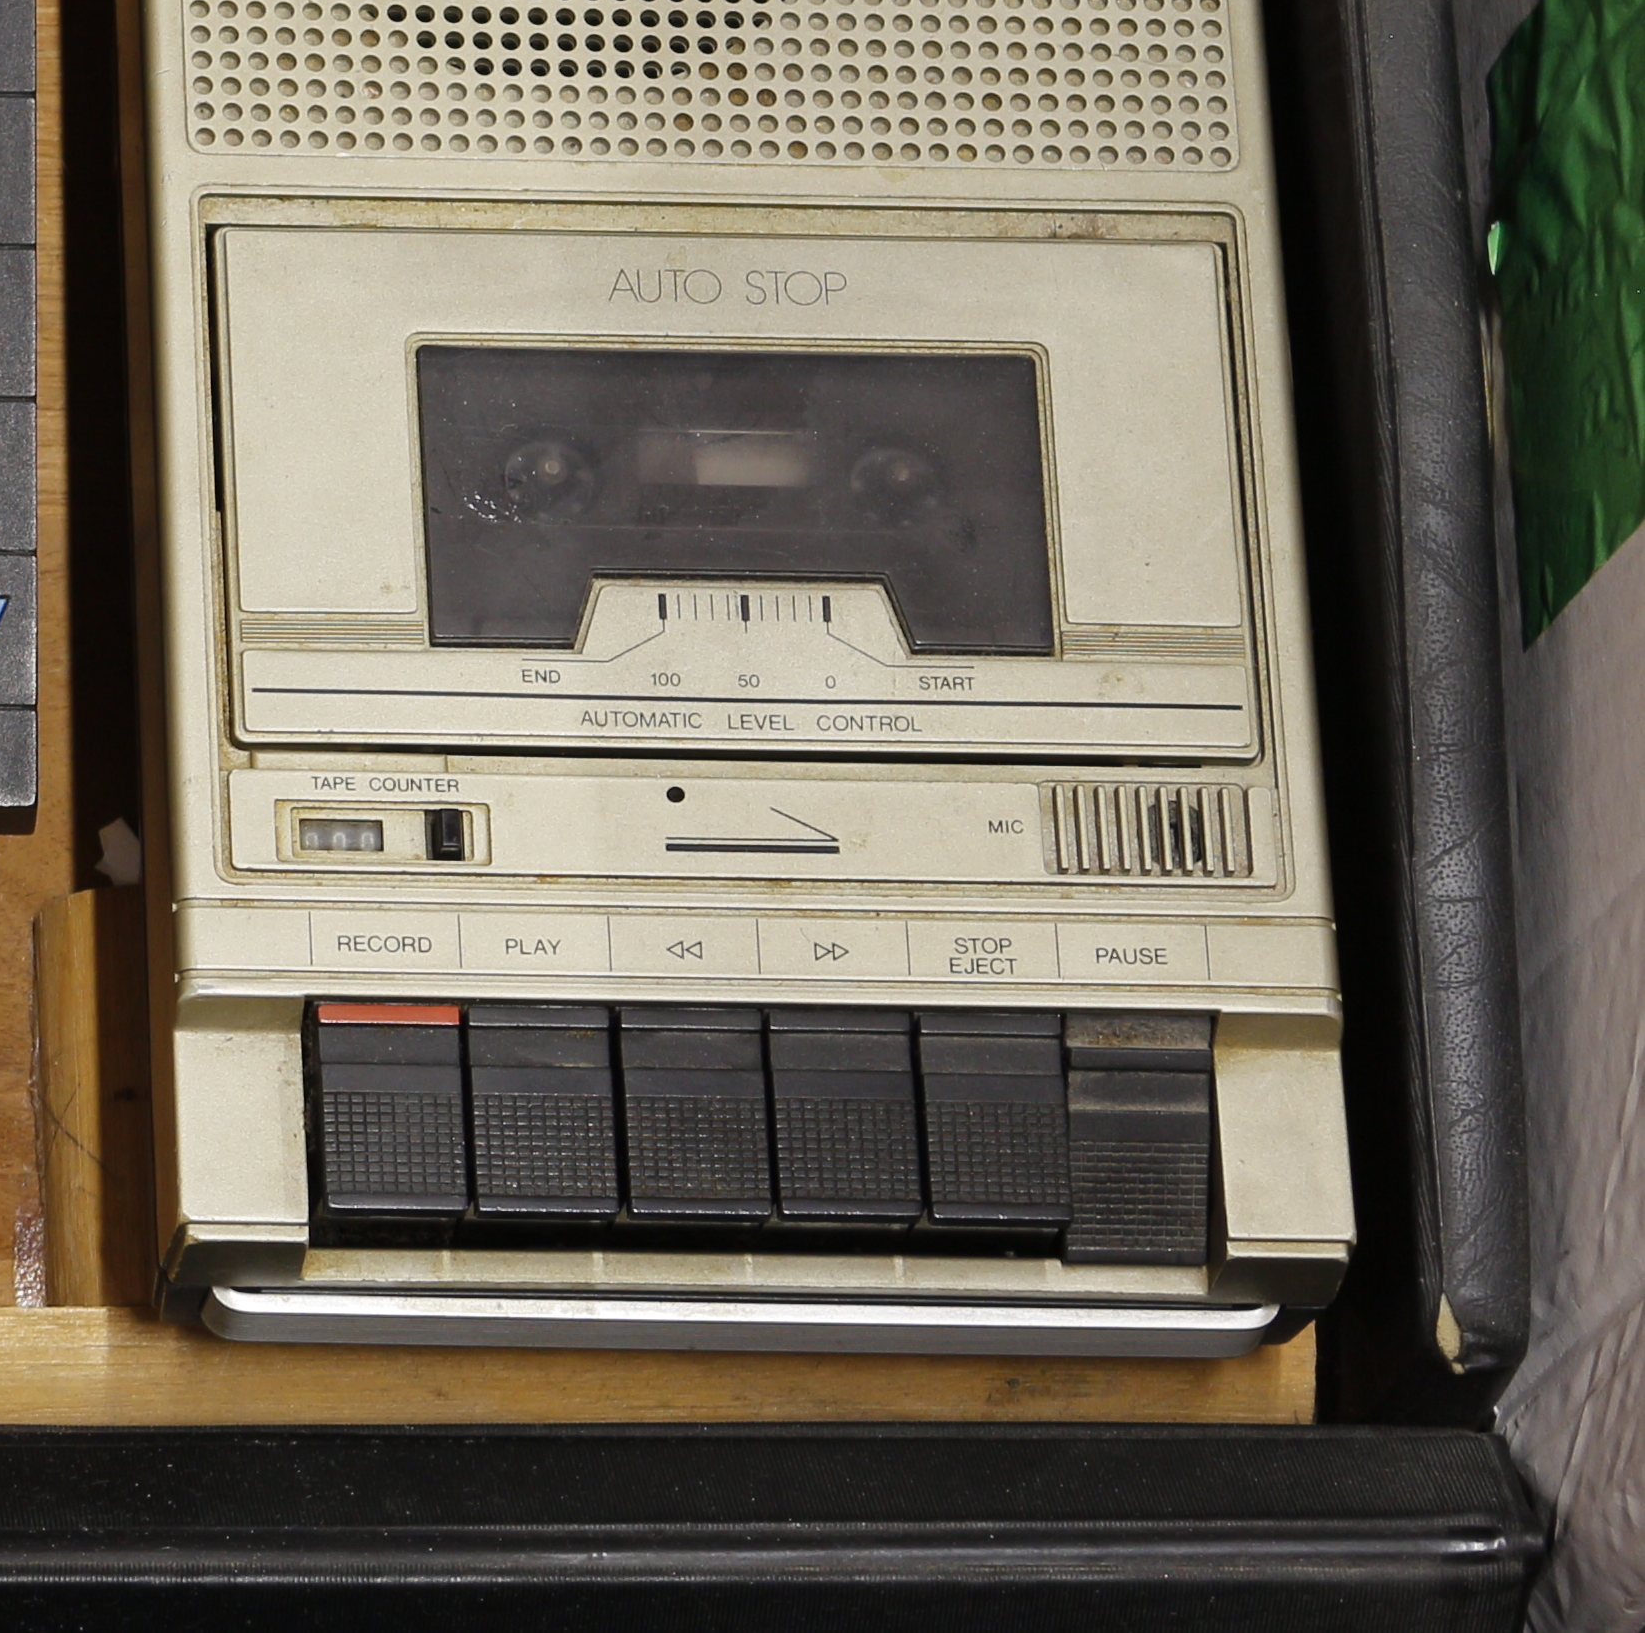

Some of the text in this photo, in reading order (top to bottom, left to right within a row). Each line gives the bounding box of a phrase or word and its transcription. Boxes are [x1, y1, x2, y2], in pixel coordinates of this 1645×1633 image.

[608, 268, 848, 306] AUTO STOP
[521, 668, 561, 684] END
[650, 672, 837, 690] 100 50 0
[918, 675, 975, 691] START
[580, 710, 923, 733] AUTOMATIC LEVEL CONTROL
[311, 775, 460, 793] TAPE COUNTER
[988, 819, 1024, 835] MIC
[337, 935, 433, 954] RECORD
[505, 938, 561, 955] PLAY
[954, 937, 1013, 955] STOP
[1095, 947, 1168, 965] PAUSE
[949, 956, 1018, 976] EJECT
